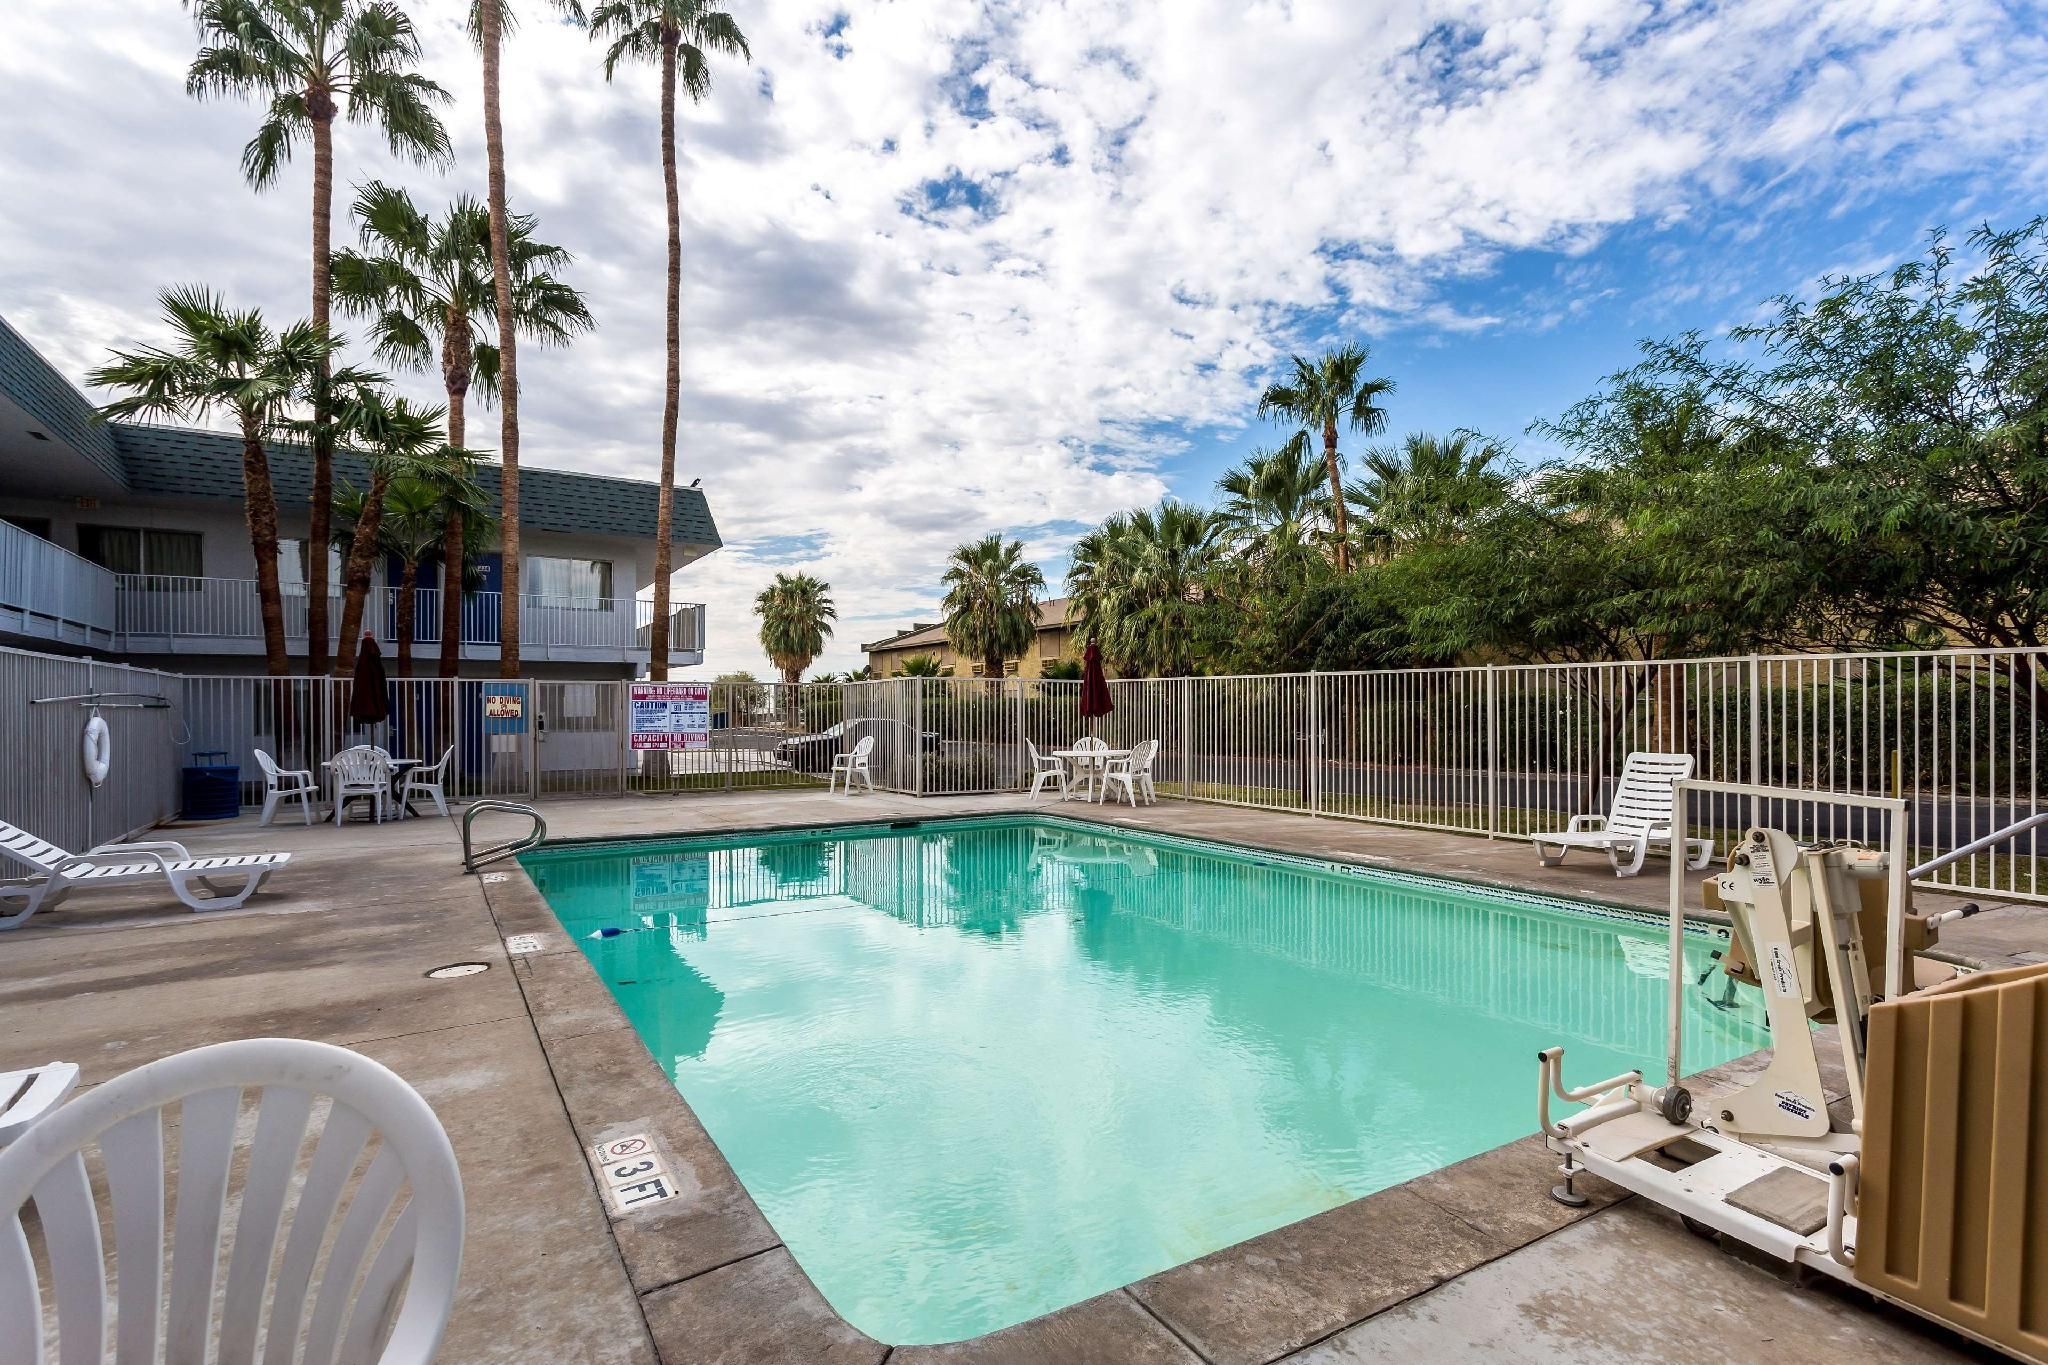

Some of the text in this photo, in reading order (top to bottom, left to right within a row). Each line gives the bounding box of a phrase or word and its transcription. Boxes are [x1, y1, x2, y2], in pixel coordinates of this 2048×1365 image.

[694, 687, 707, 695] DUTY
[486, 696, 521, 704] NO DIVING
[634, 701, 668, 709] CAUTION
[489, 709, 519, 717] ALLOWED
[633, 734, 669, 742] CAPACITY
[673, 733, 706, 741] NO DIVING
[614, 1161, 654, 1178] 3
[620, 1178, 668, 1205] FT
